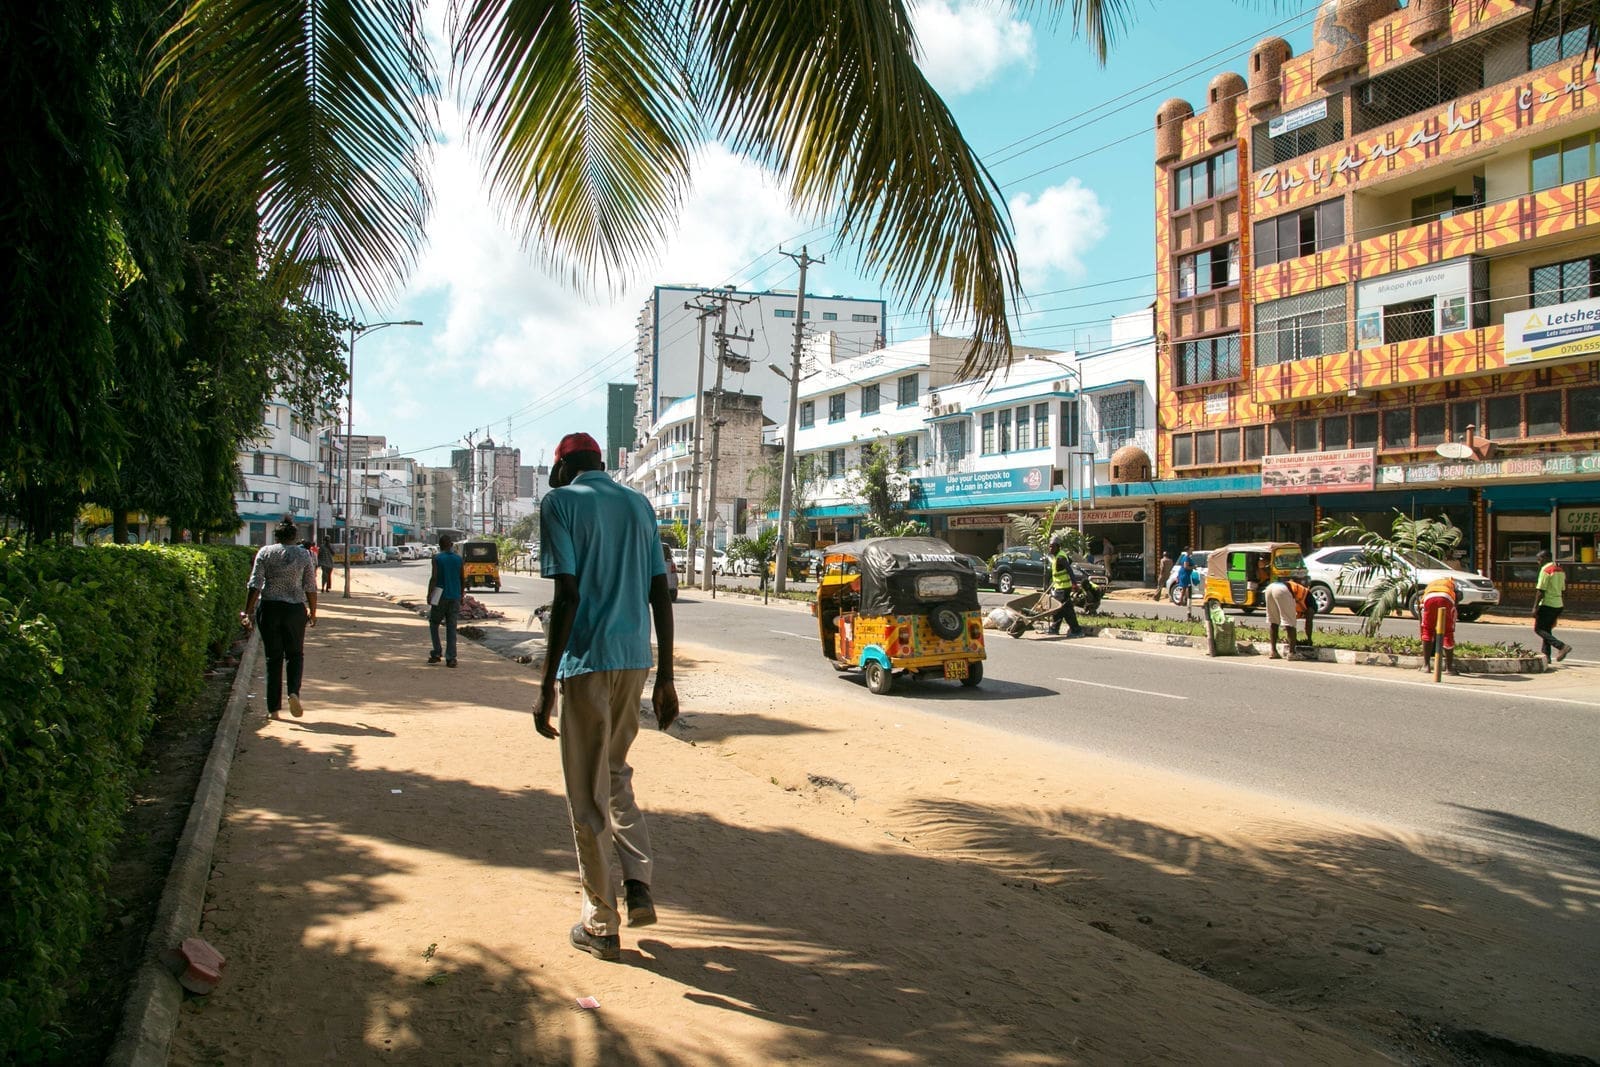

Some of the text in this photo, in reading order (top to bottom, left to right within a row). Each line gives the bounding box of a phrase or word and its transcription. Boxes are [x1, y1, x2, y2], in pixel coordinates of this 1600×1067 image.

[1378, 273, 1445, 293] Mikopo Kwa Wote
[1561, 342, 1600, 354] 0700 555
[850, 355, 885, 373] CHAMBERS
[1275, 456, 1305, 464] PREMIUM
[1307, 454, 1340, 462] AUTOMART
[1343, 451, 1371, 459] LIMITED
[1465, 462, 1502, 475] GLOBAL
[947, 471, 1010, 486] Use your Logbook to
[1029, 471, 1039, 482] 24
[945, 484, 955, 494] get
[961, 483, 976, 491] Loan
[976, 481, 983, 490] in
[984, 481, 992, 490] 24
[993, 480, 1012, 489] hours
[1087, 511, 1107, 520] KENYA
[1109, 510, 1132, 519] LIMITED
[1571, 524, 1600, 532] INSID
